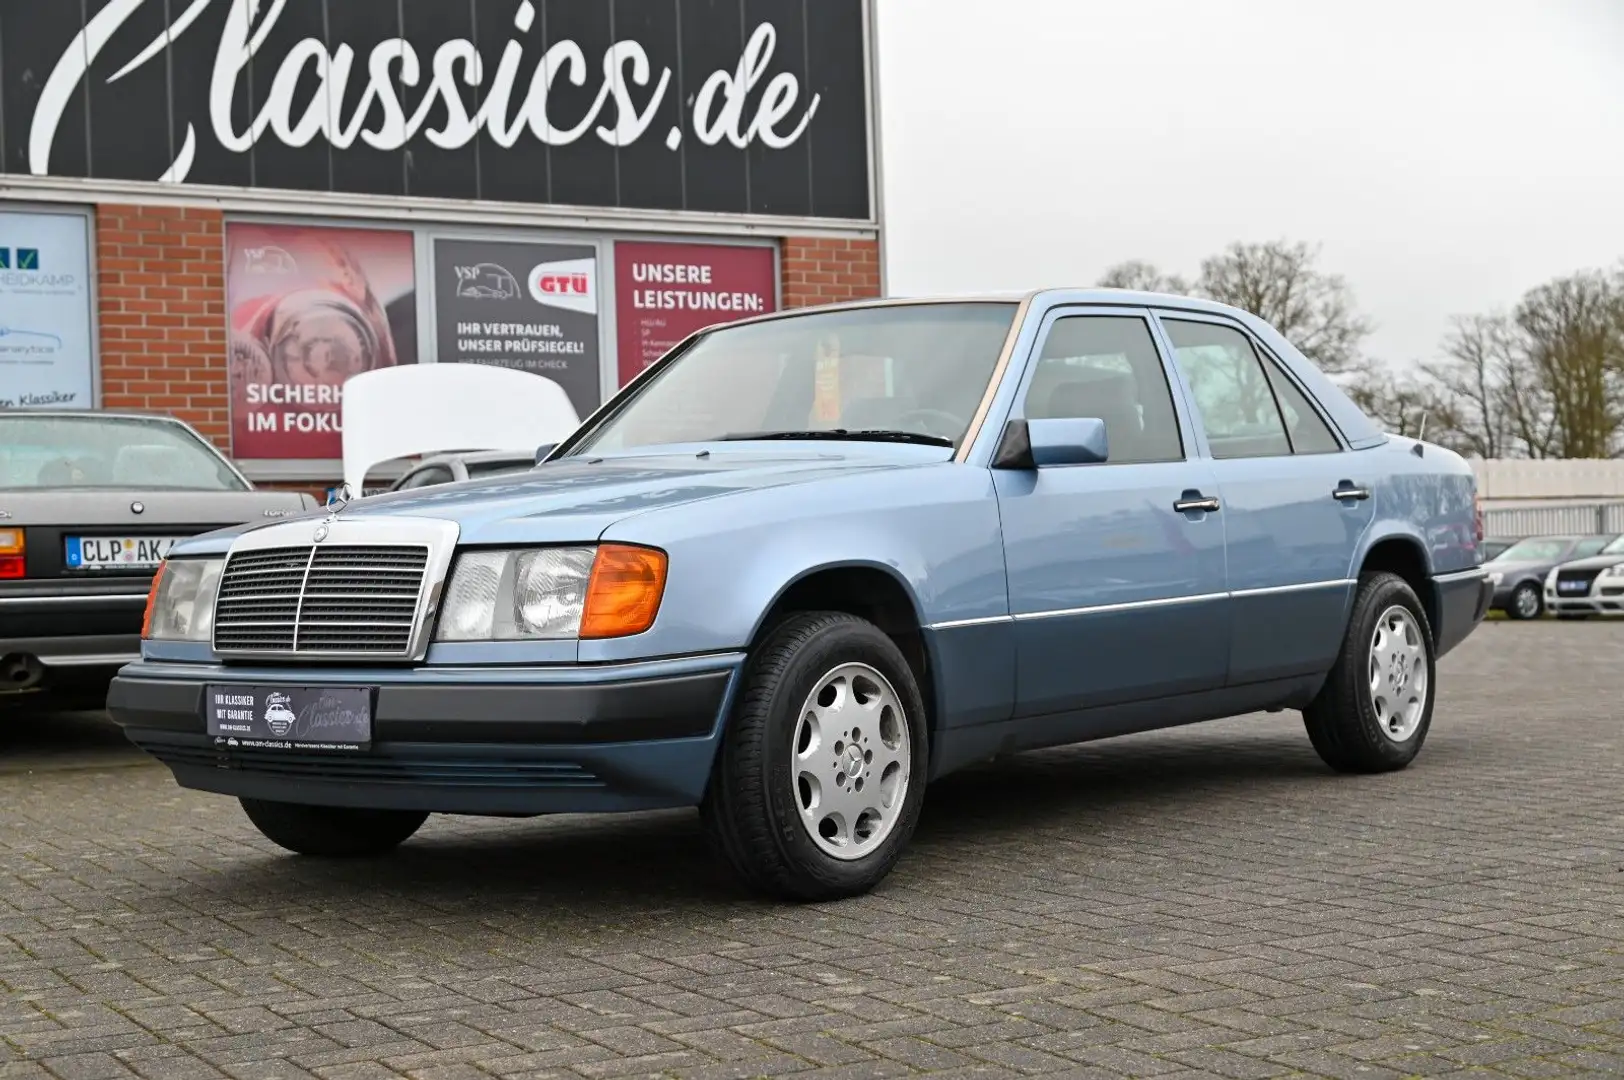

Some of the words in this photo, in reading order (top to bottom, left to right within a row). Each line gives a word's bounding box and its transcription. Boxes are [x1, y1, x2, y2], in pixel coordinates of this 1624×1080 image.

[454, 265, 480, 279] VSP
[632, 263, 712, 285] UNSERE
[539, 272, 588, 295] GTÜ
[633, 290, 764, 311] LEISTUNGEN:
[458, 322, 481, 335] IHR
[482, 323, 563, 338] VERTRAUEN,
[458, 339, 502, 352] UNSER
[505, 337, 584, 354] PRÜFSIEGEL!
[525, 360, 536, 368] IM
[538, 360, 568, 370] CHECK
[19, 391, 76, 407] Klassiker
[246, 383, 343, 404] SICHERH
[248, 412, 277, 432] IM
[284, 412, 343, 433] FOKU
[83, 540, 122, 562] CLP
[139, 540, 162, 561] AK
[225, 695, 254, 707] KLASSIKER
[216, 709, 226, 720] MIT
[227, 710, 254, 721] GARANTIE
